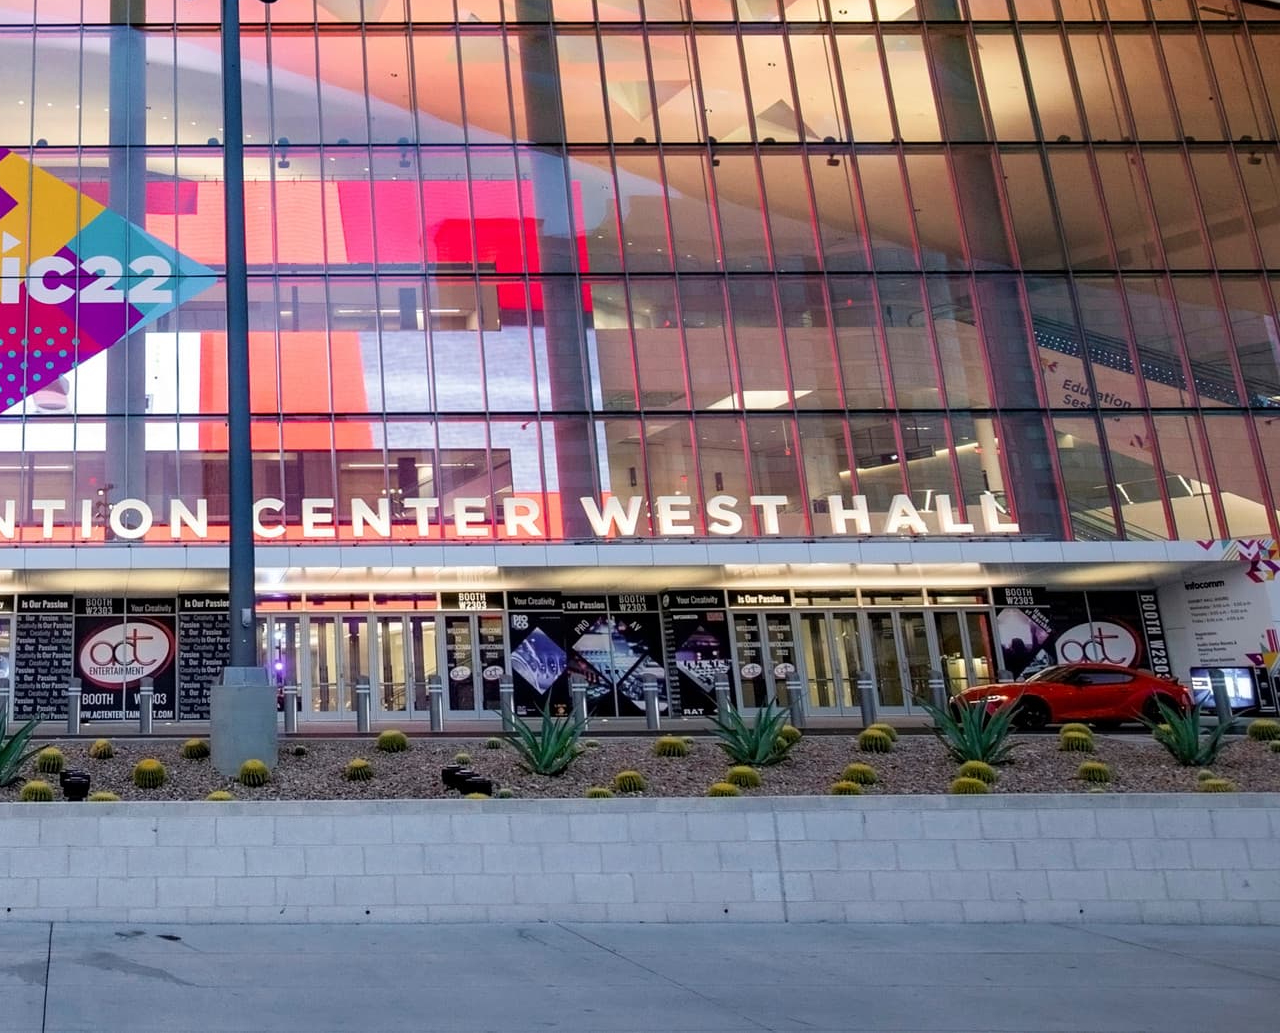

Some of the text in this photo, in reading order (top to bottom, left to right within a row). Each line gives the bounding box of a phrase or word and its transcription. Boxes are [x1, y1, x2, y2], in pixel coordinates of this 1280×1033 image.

[252, 497, 543, 538] CENTER
[580, 495, 789, 536] WEST
[828, 494, 1020, 534] HALL
[1184, 580, 1225, 591] infocomm
[459, 592, 486, 601] BOOTH
[1005, 588, 1032, 597] BOOTH
[192, 599, 204, 607] Our
[514, 597, 555, 606] Your Creativity
[619, 595, 645, 603] BOOTH
[676, 596, 690, 604] Your
[691, 596, 718, 605] Creativity
[745, 595, 758, 603] Our
[759, 595, 785, 603] Passion
[1006, 597, 1034, 605] W2303
[29, 600, 41, 608] Our
[43, 600, 68, 608] Passion
[131, 604, 172, 613] Your Creativity
[459, 601, 487, 609] W2303
[567, 601, 579, 609] Our
[580, 601, 605, 609] Passion
[620, 603, 647, 612] W2303
[1141, 595, 1162, 635] BOOTH
[574, 619, 590, 635] PRO
[90, 628, 157, 666] act
[82, 693, 114, 705] BOOTH
